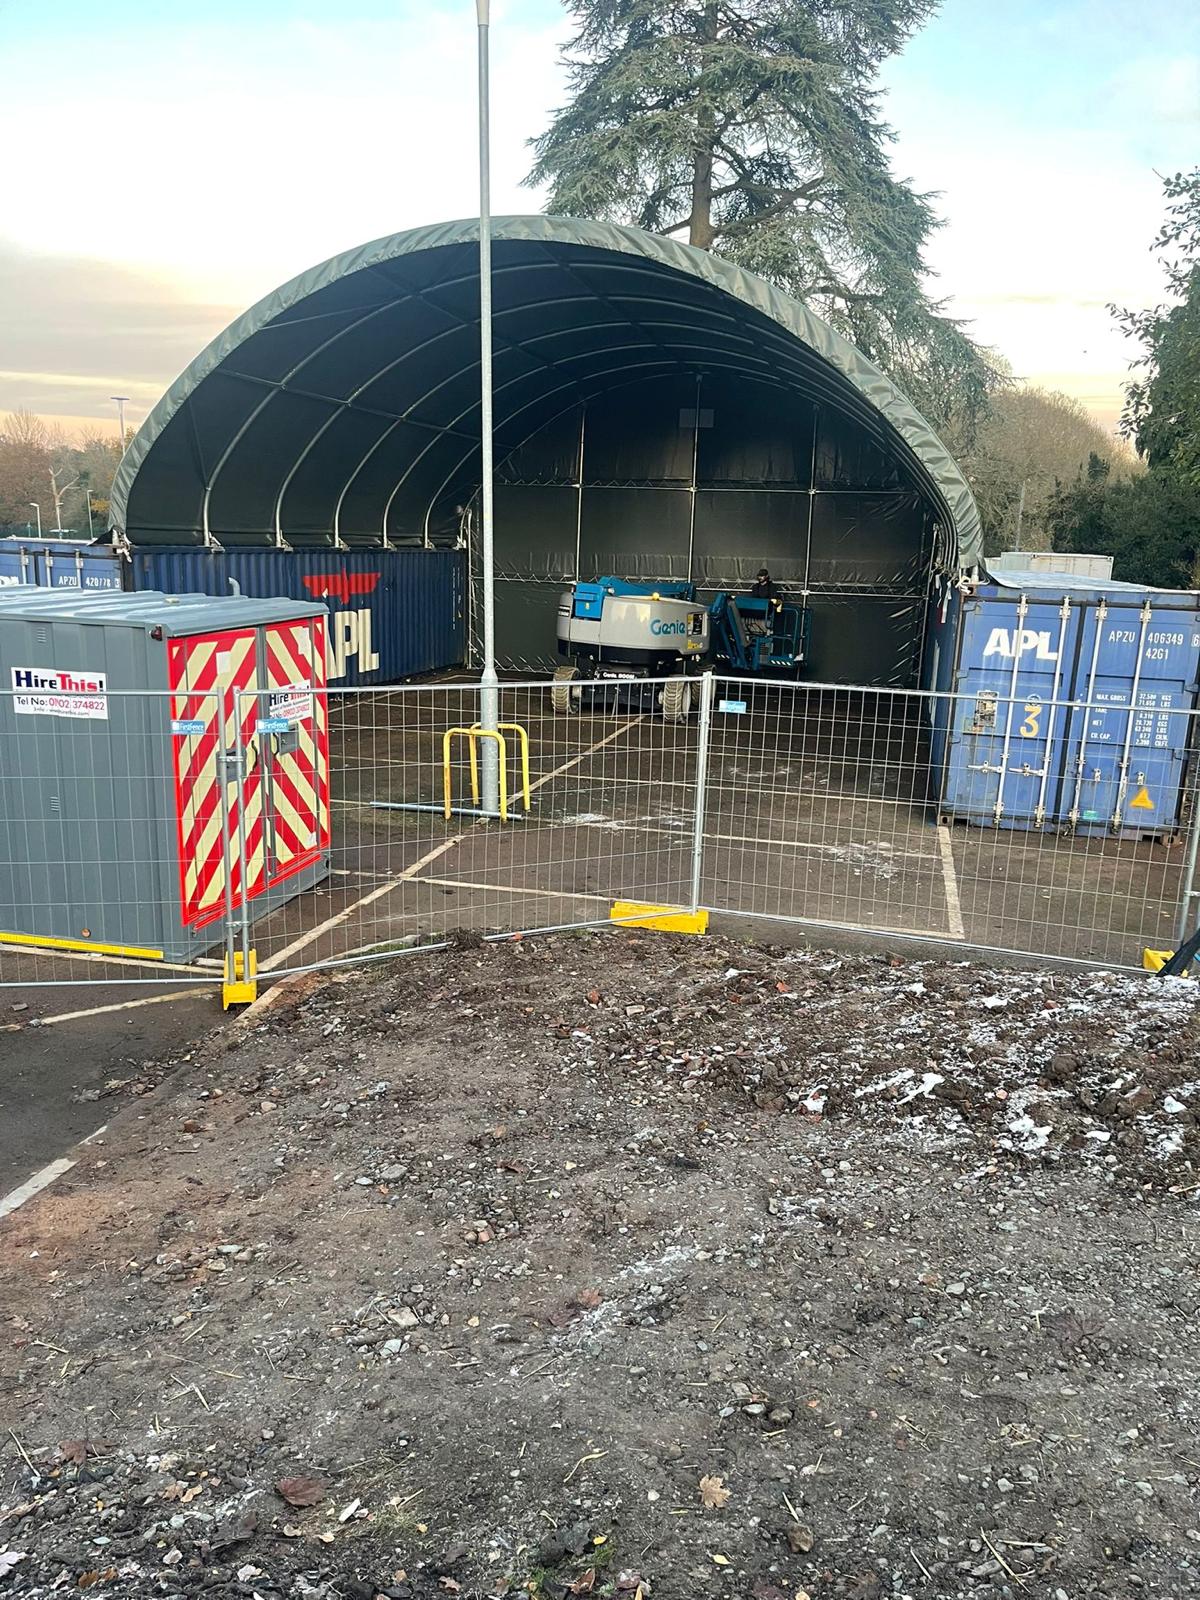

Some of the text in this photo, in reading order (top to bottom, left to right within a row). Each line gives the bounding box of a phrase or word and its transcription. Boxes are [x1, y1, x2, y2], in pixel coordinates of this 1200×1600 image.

[59, 575, 77, 586] APZU
[651, 619, 686, 636] Genie
[983, 628, 1058, 660] APL
[1108, 630, 1136, 643] APZU
[1147, 632, 1184, 645] 406349
[1145, 648, 1169, 660] 42G1
[17, 696, 29, 706] Tel
[49, 697, 70, 709] 002
[73, 699, 105, 711] 374822
[1020, 705, 1042, 737] 3
